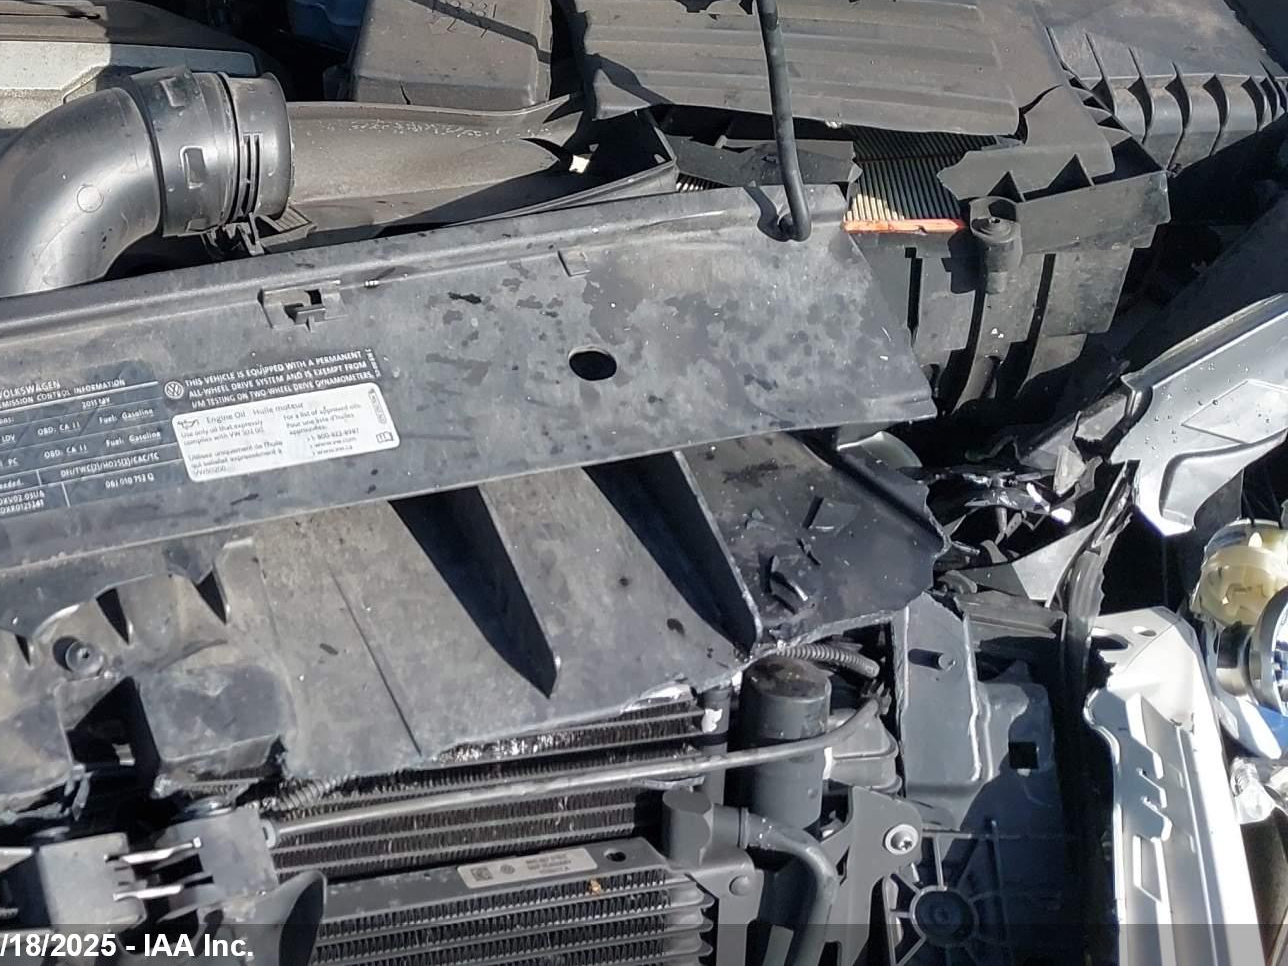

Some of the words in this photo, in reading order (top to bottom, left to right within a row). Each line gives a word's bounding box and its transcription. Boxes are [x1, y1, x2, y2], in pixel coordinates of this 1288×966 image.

[185, 378, 203, 387] THIS
[204, 371, 235, 385] VEHICLE
[236, 370, 244, 379] IS
[245, 363, 284, 378] EQUIPPED
[285, 360, 307, 371] WITH
[308, 359, 314, 367] A
[315, 350, 362, 365] PERMANENT
[189, 384, 230, 398] ALL-WHEEL
[231, 380, 254, 390] DRIVE
[255, 375, 284, 387] SYSTEM
[286, 371, 303, 382] AND
[304, 370, 312, 378] IS
[313, 365, 342, 377] EXEMPT
[344, 360, 367, 372] FROM
[36, 389, 70, 402] CONTROL
[73, 379, 126, 394] INFORMATION
[207, 395, 236, 406] TESTING
[237, 392, 249, 401] ON
[292, 380, 314, 392] DRIVE
[59, 422, 70, 432] CA
[121, 408, 154, 420] Gasoline
[128, 430, 161, 443] Gasoline
